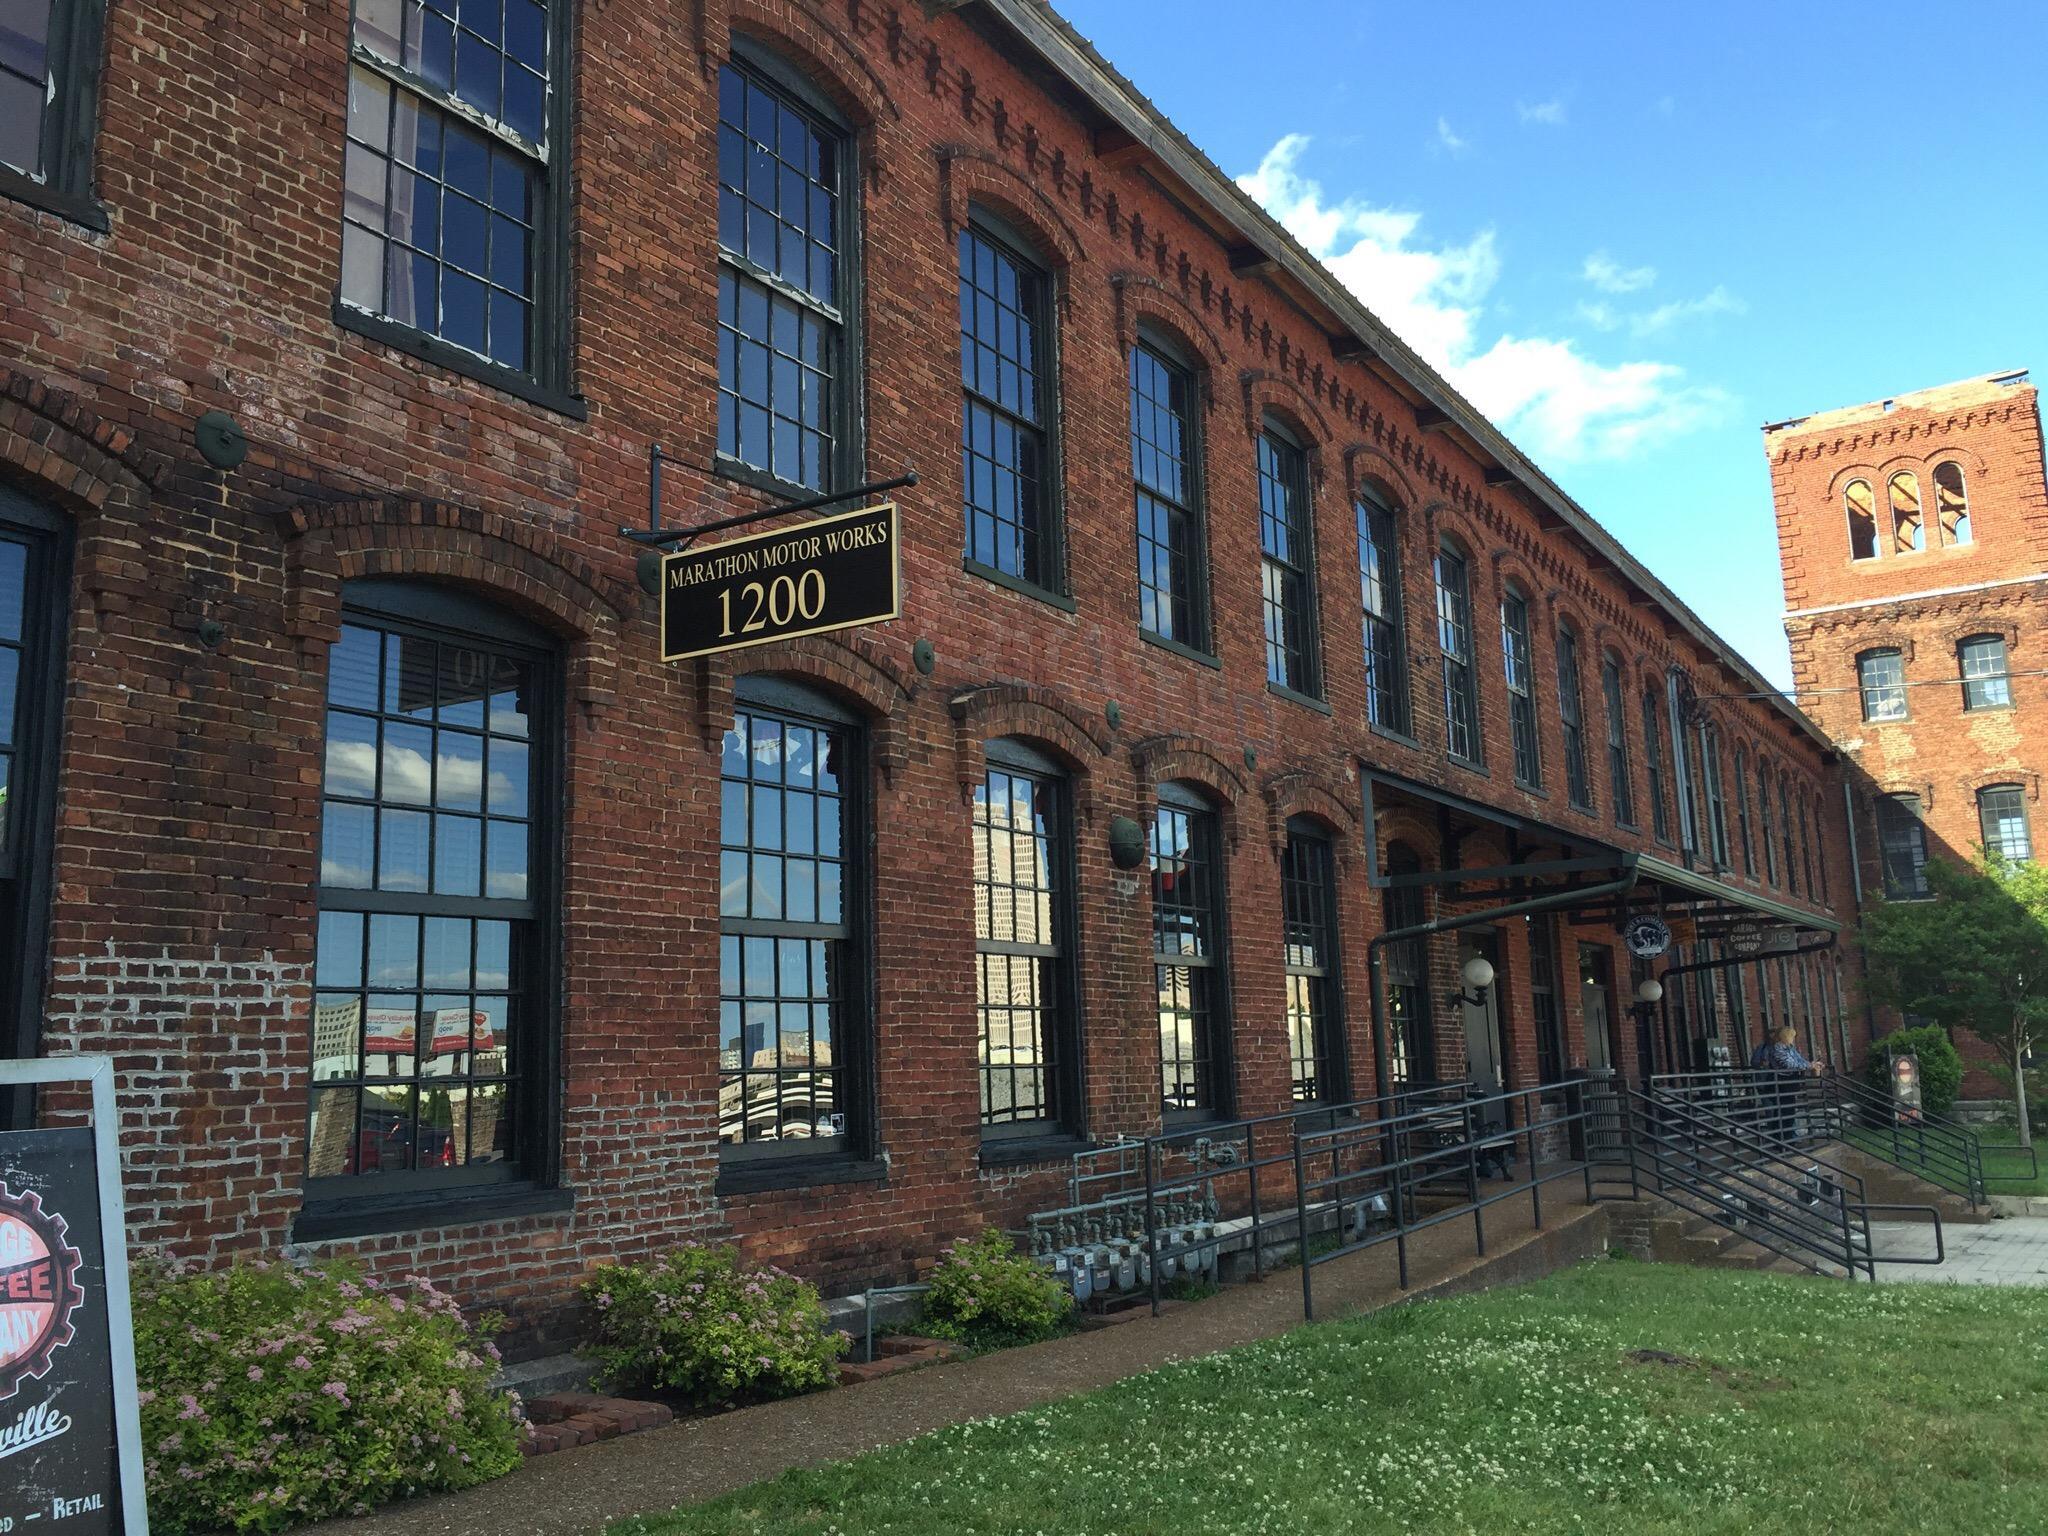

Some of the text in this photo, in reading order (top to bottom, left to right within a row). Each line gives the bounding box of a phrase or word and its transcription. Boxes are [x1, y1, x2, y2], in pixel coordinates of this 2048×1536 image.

[670, 521, 887, 589] MARATHON MOTOR WORKS
[718, 569, 826, 638] 1200
